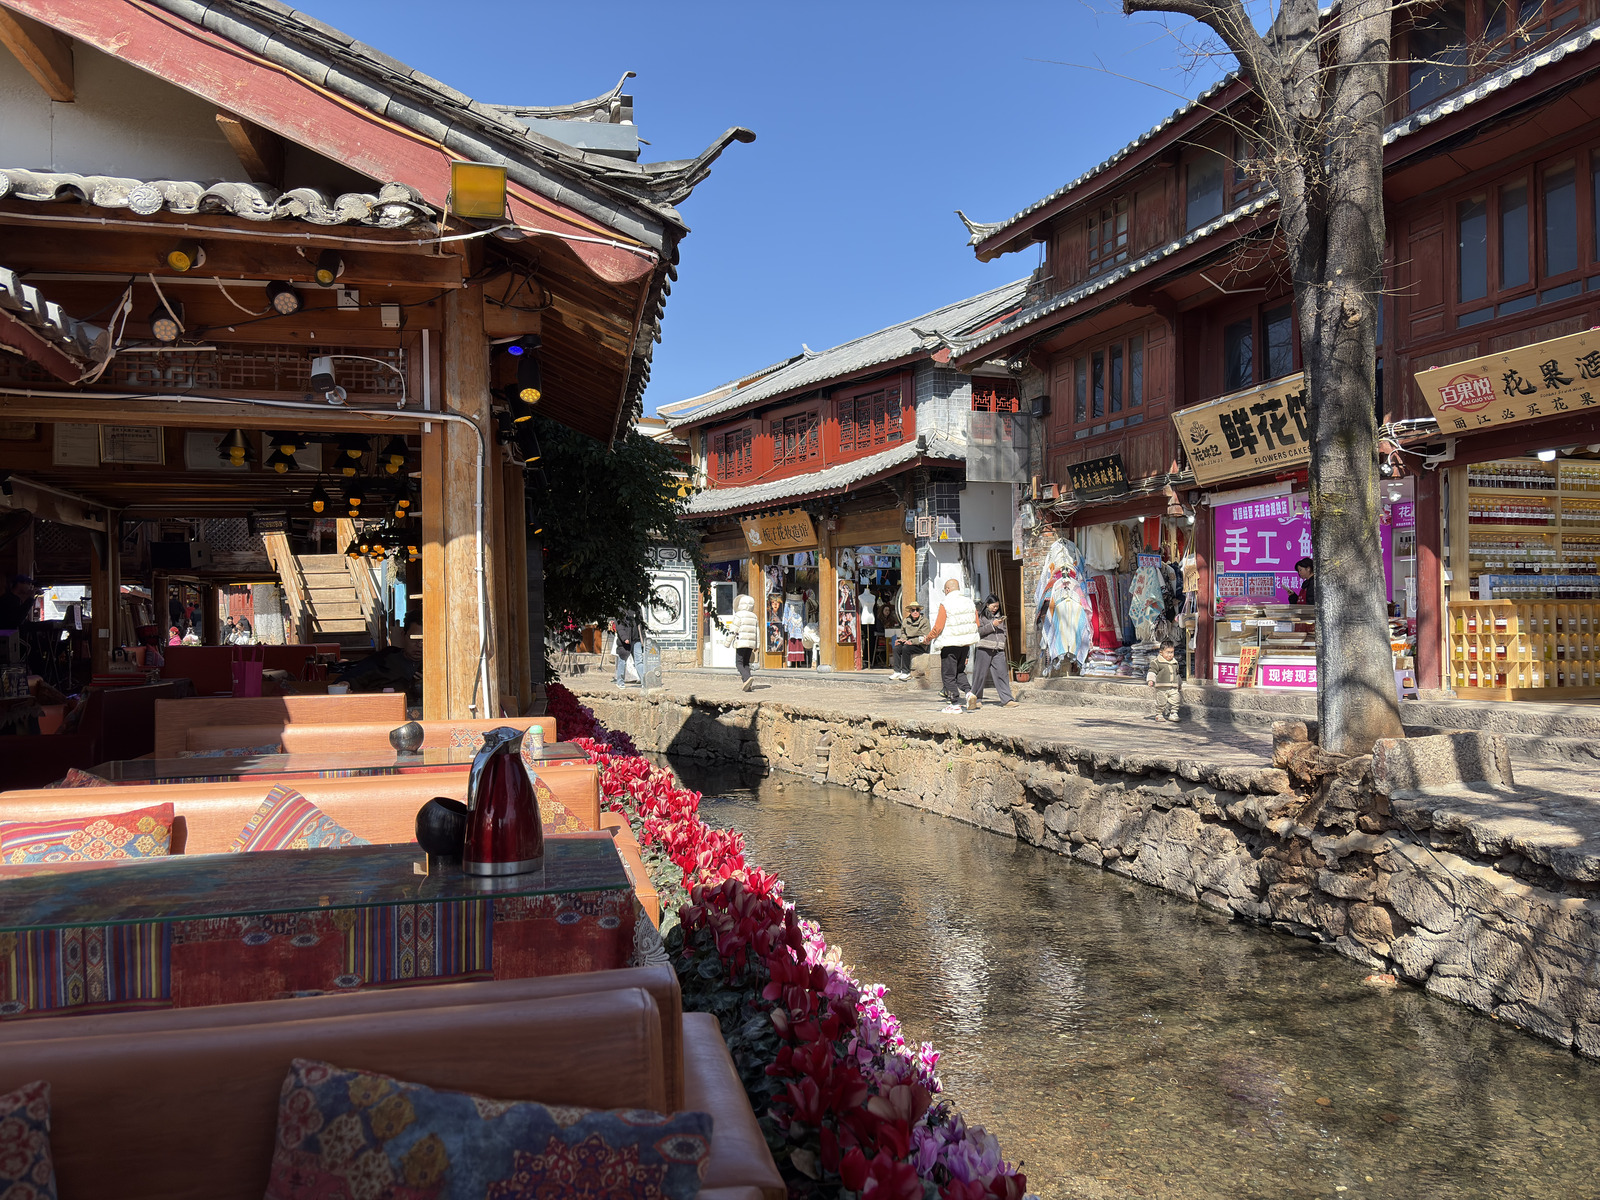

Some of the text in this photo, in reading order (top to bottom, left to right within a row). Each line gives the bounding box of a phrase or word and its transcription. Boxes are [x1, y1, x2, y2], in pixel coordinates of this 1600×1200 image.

[1501, 350, 1600, 397] 花果酒
[1440, 377, 1494, 405] 百果悦
[1483, 394, 1495, 402] YUE
[1452, 391, 1597, 429] 丽江必买花果
[1254, 445, 1312, 465] FLOWERS CAKES
[1268, 668, 1317, 683] 现烤现卖
